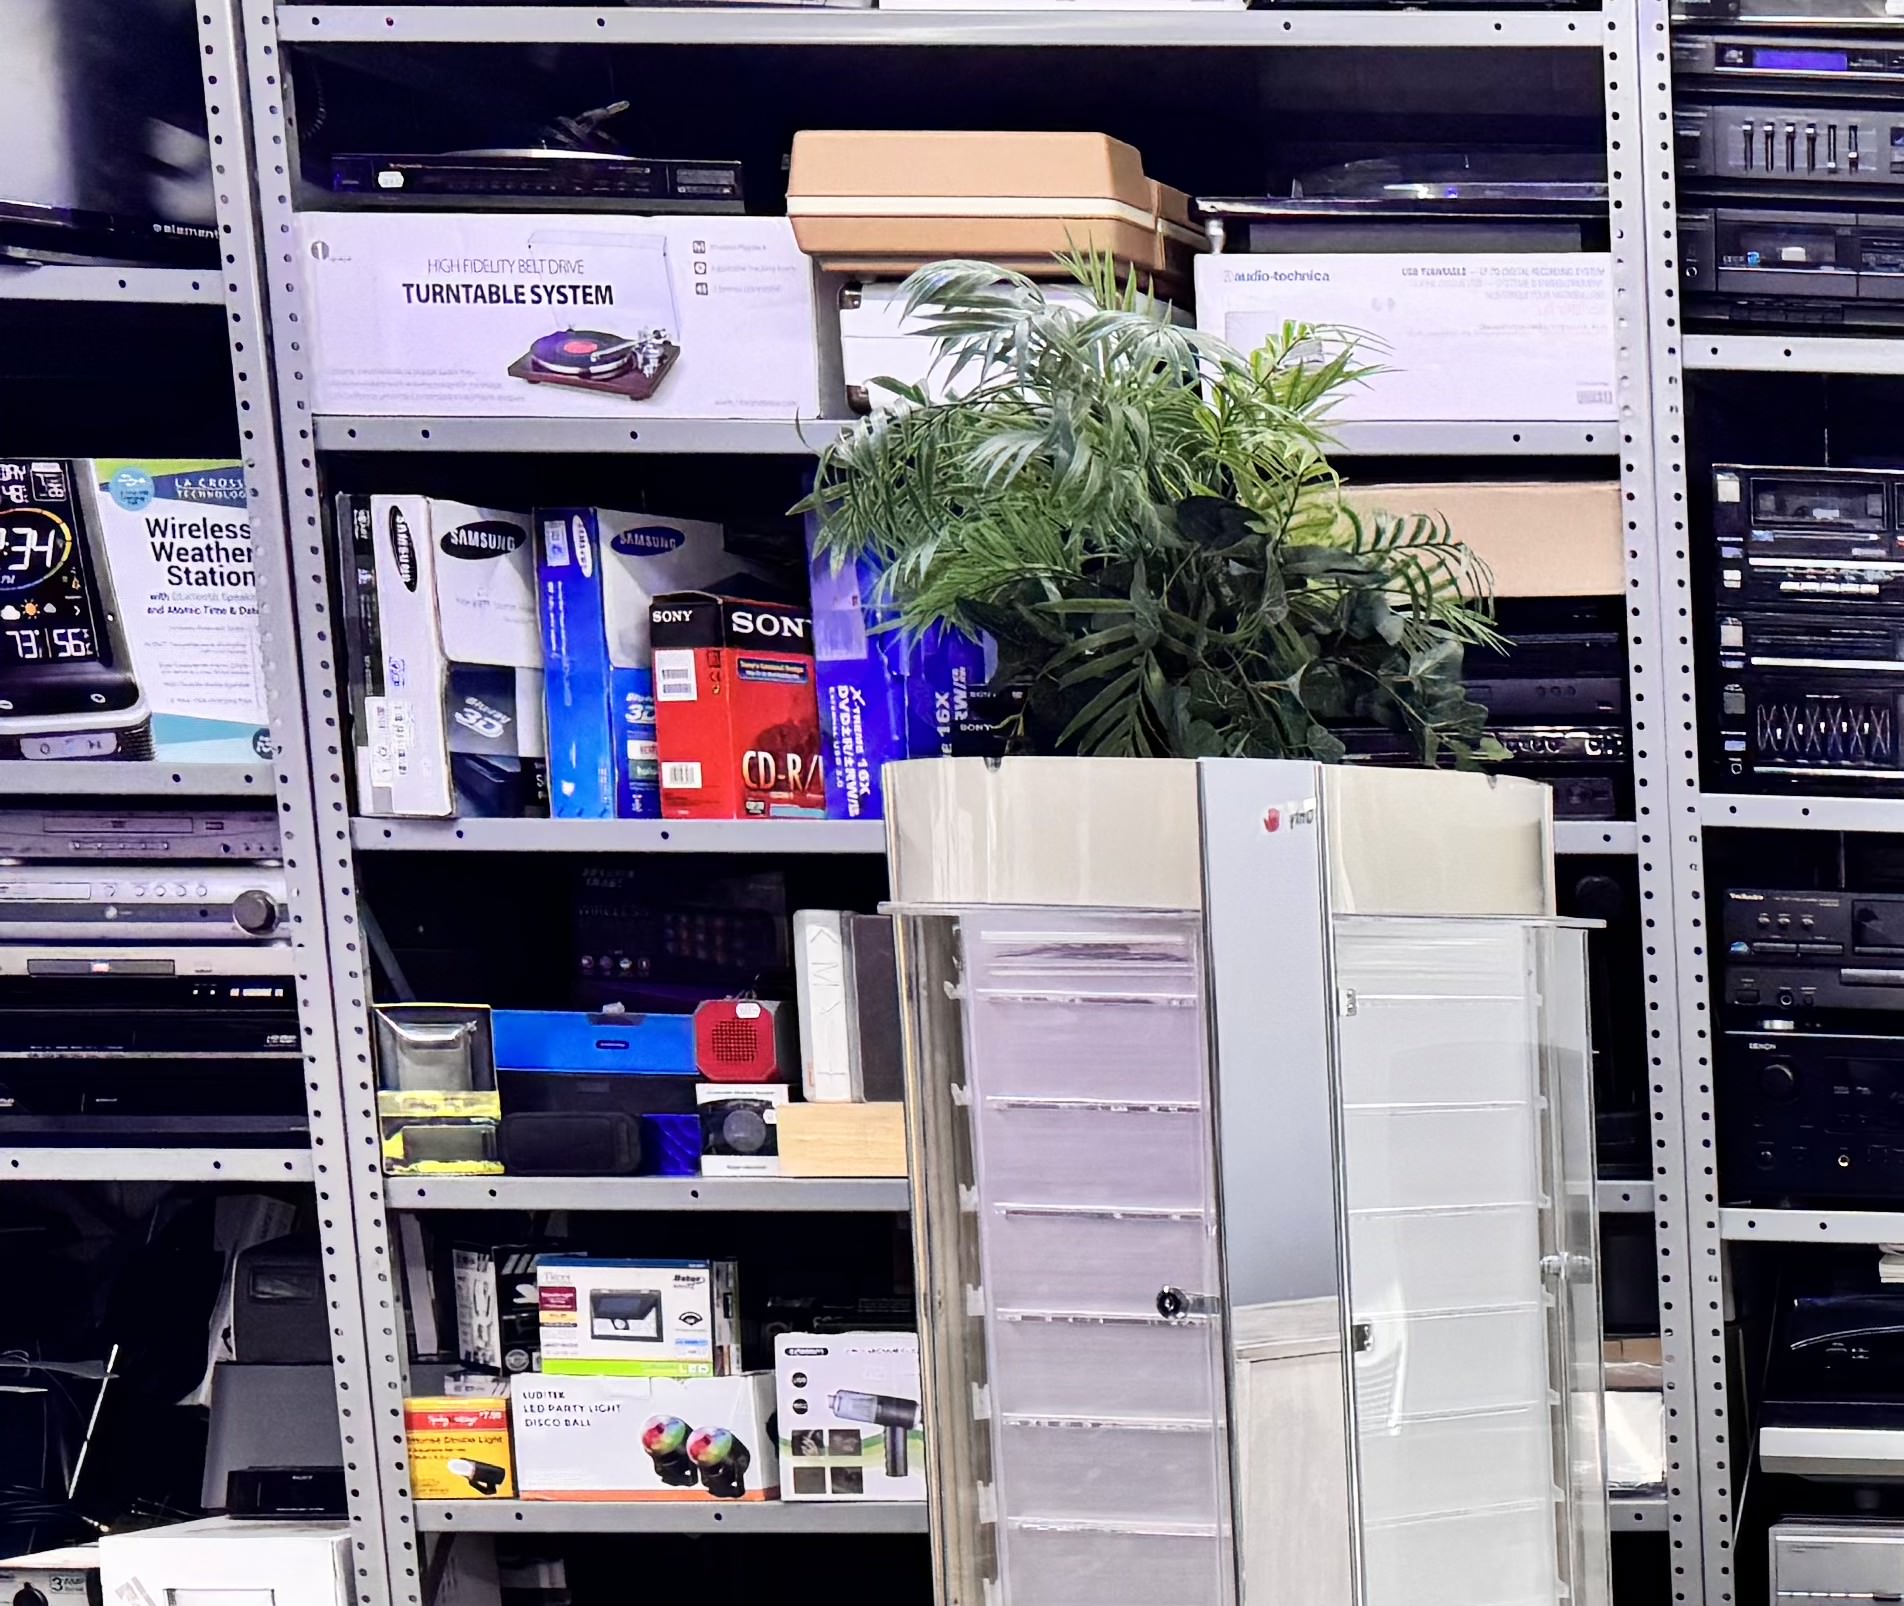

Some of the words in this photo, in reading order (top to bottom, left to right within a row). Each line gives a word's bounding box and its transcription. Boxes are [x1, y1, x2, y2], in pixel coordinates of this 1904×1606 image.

[428, 258, 461, 275] HIGH
[463, 258, 516, 275] FIDELITY
[518, 258, 545, 275] BELT
[548, 258, 585, 275] DRIVE
[402, 283, 526, 306] TURNTABLE
[531, 283, 615, 306] SYSTEM
[145, 517, 251, 540] Wireless
[450, 529, 516, 552] SAMSUNG
[619, 530, 676, 550] SAMSUNG
[150, 541, 253, 564] Weather
[167, 565, 256, 587] Station
[652, 609, 693, 623] SONY
[454, 705, 505, 738] 3D
[856, 758, 871, 796] 16X
[523, 1404, 545, 1413] LED
[548, 1404, 586, 1413] PARTY
[588, 1404, 622, 1413] LIGHT
[525, 1418, 561, 1428] DISCO
[564, 1418, 591, 1428] BALL
[50, 1577, 63, 1592] 3
